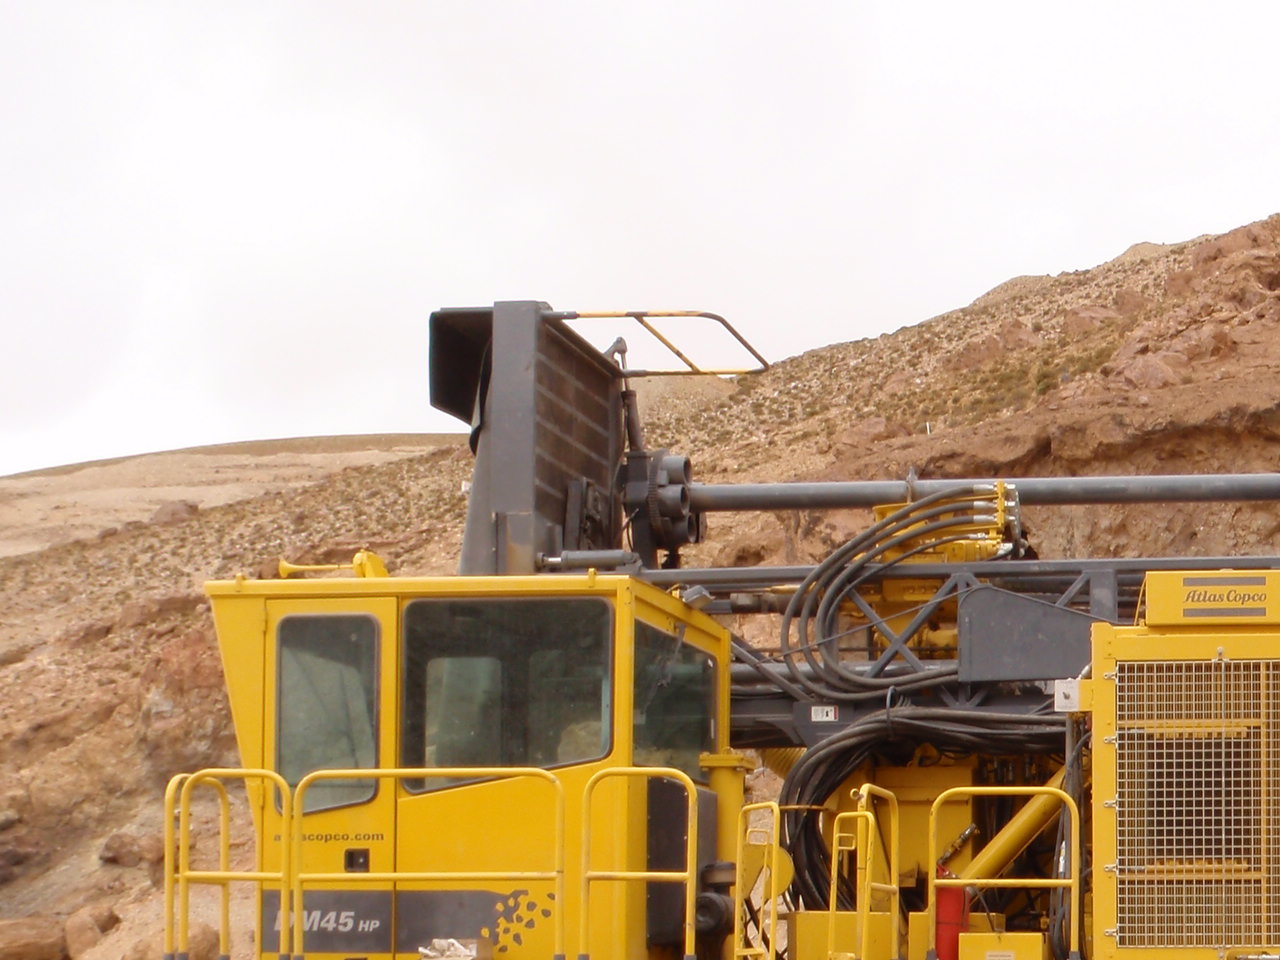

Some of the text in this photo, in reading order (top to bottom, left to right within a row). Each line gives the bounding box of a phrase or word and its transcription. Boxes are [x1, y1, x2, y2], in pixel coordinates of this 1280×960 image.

[1184, 589, 1267, 605] Atlas Copco
[358, 920, 380, 932] HP
